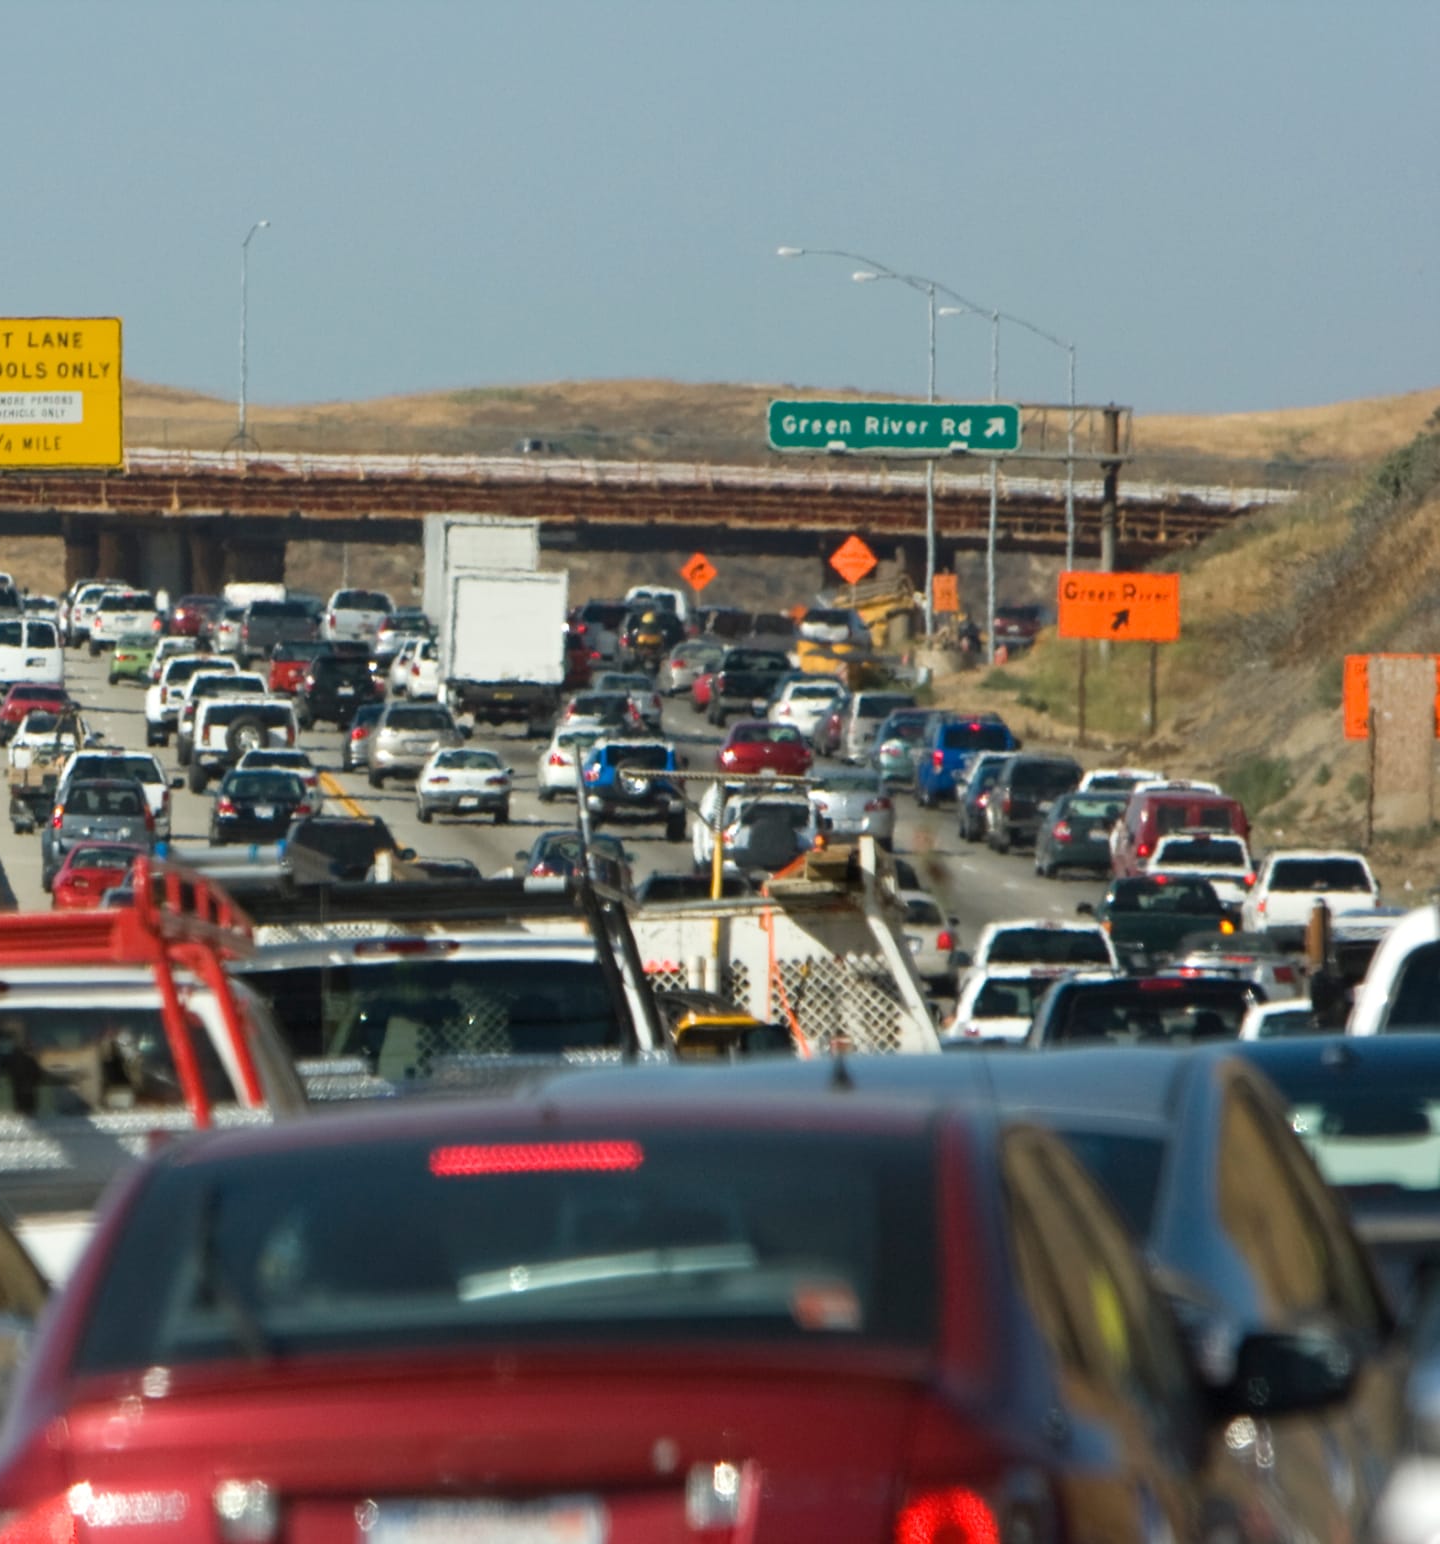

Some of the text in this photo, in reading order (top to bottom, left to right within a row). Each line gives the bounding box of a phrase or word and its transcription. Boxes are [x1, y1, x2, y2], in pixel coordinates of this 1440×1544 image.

[27, 331, 83, 349] LANE
[57, 361, 111, 379] ONLY
[0, 396, 25, 406] MORE
[31, 395, 73, 406] PERSONS
[42, 408, 66, 418] ONLY
[781, 415, 972, 437] Green River Rd
[22, 435, 62, 451] MILE
[1063, 581, 1170, 601] Green River
